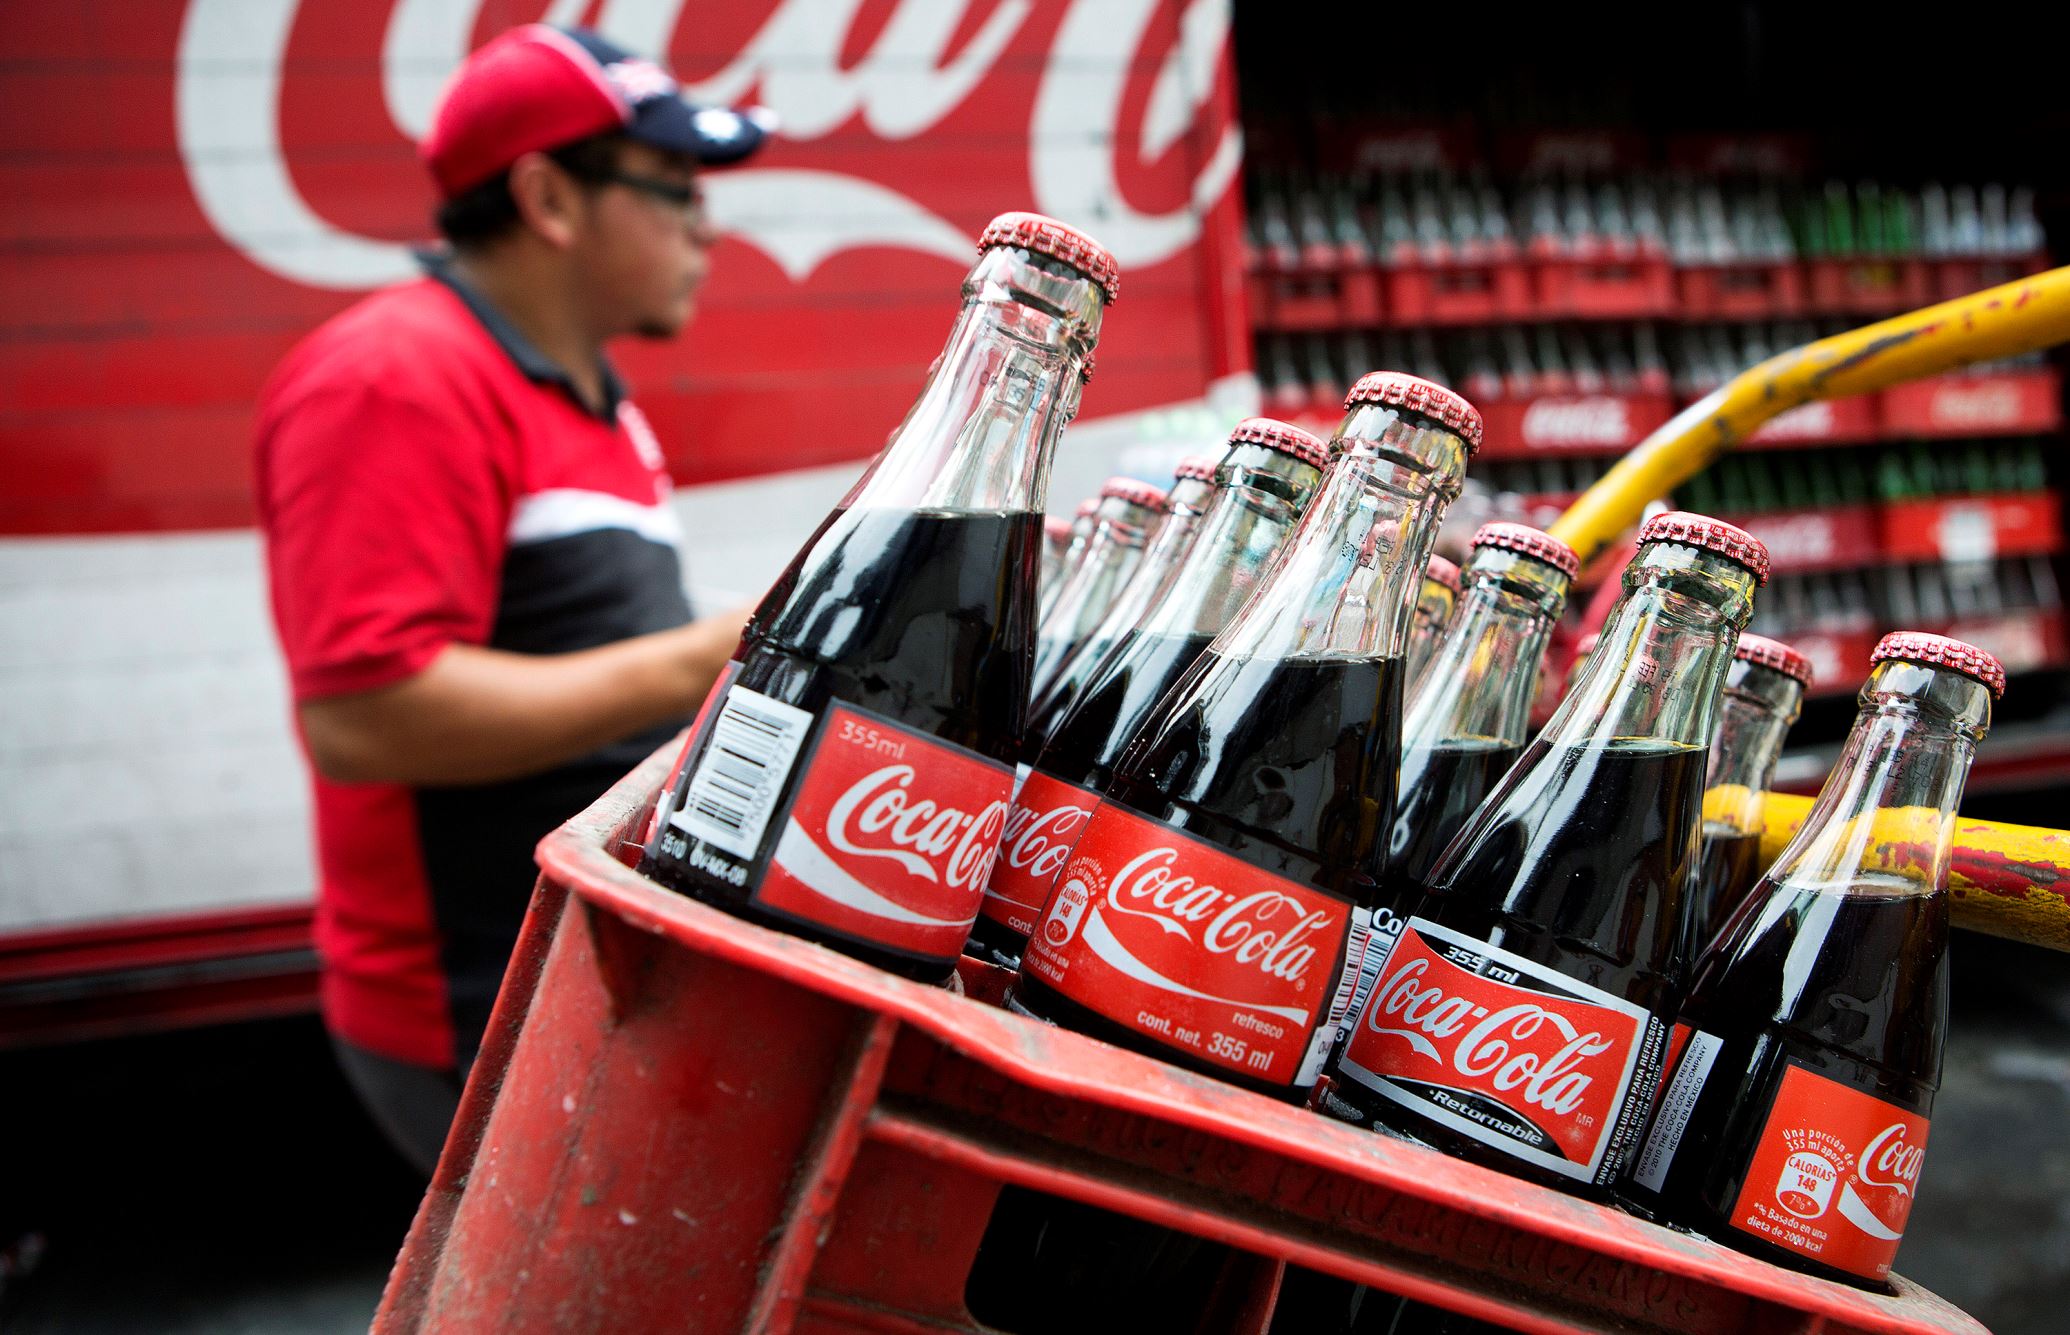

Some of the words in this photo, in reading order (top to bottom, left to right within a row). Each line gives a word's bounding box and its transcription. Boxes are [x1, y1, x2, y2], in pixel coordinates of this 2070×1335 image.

[839, 720, 905, 760] 355ml
[826, 764, 1009, 893] Coca-Co
[1106, 846, 1336, 983] Coca-Cola
[1372, 907, 1407, 936] Co
[1443, 946, 1487, 973] 355
[1488, 966, 1520, 984] ml
[1137, 1011, 1171, 1035] cont.
[1174, 1026, 1202, 1048] net.
[1207, 1032, 1248, 1062] 355
[1248, 1050, 1275, 1071] ml
[1232, 1012, 1284, 1039] refresco
[1368, 957, 1614, 1116] Coca-Cola
[1596, 1149, 1618, 1186] ENVASE
[1612, 1095, 1636, 1149] EXCLUSIVO
[1630, 1068, 1646, 1095] PARA
[1640, 1016, 1659, 1068] REFRESCO
[1623, 1126, 1635, 1146] THE
[1630, 1073, 1653, 1127] COCA-COLA
[1648, 1022, 1666, 1072] COMPANY
[1657, 1132, 1669, 1150] THE
[1666, 1083, 1690, 1133] COCA-COLA
[1686, 1044, 1707, 1086] COMPANY
[1637, 1143, 1654, 1178] ENVASE
[1649, 1100, 1672, 1144] EXCLUSIVO
[1667, 1075, 1682, 1101] PARA
[1679, 1037, 1702, 1079] REFRESCO
[1668, 1121, 1684, 1152] HECHO
[1680, 1108, 1691, 1124] EN
[1782, 1128, 1805, 1141] Una
[1808, 1129, 1845, 1153] porción
[1844, 1152, 1854, 1167] de
[1786, 1138, 1805, 1152] 355
[1808, 1139, 1821, 1151] ml
[1820, 1144, 1845, 1173] aporta
[1797, 1174, 1818, 1192] 148
[1746, 1215, 1771, 1234] dieta
[1771, 1222, 1784, 1238] de
[1805, 1236, 1823, 1254] kcal
[1767, 1208, 1800, 1230] Basado
[1800, 1222, 1812, 1235] en
[1812, 1228, 1828, 1241] una
